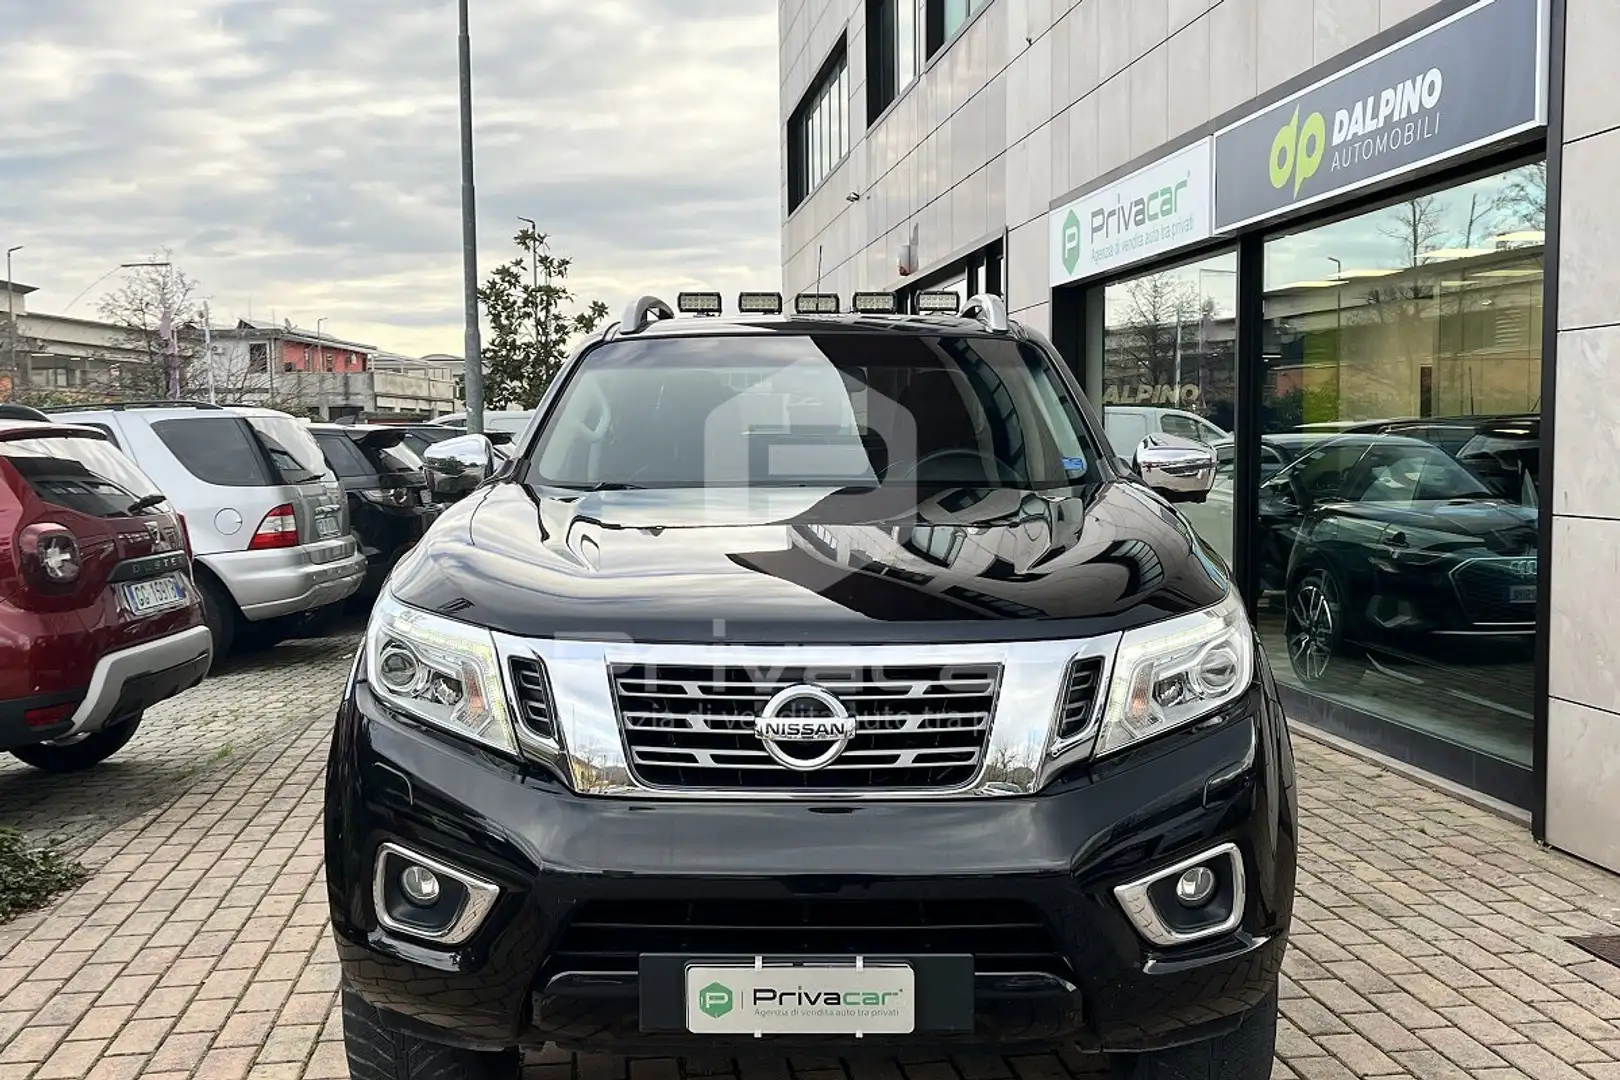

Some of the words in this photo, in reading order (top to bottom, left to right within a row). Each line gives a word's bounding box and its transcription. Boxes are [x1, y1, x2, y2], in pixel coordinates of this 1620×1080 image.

[1332, 68, 1442, 146] DALPINO
[1331, 112, 1440, 172] AUTOMOBILI
[1091, 179, 1188, 244] Privacar
[765, 723, 845, 736] NISSAN
[753, 985, 899, 1006] Privacar
[754, 1008, 789, 1018] Agenzia
[791, 1008, 799, 1017] di
[800, 1008, 834, 1017] vendita
[835, 1008, 856, 1017] auto
[858, 1008, 868, 1017] tra
[870, 1008, 899, 1018] privati
